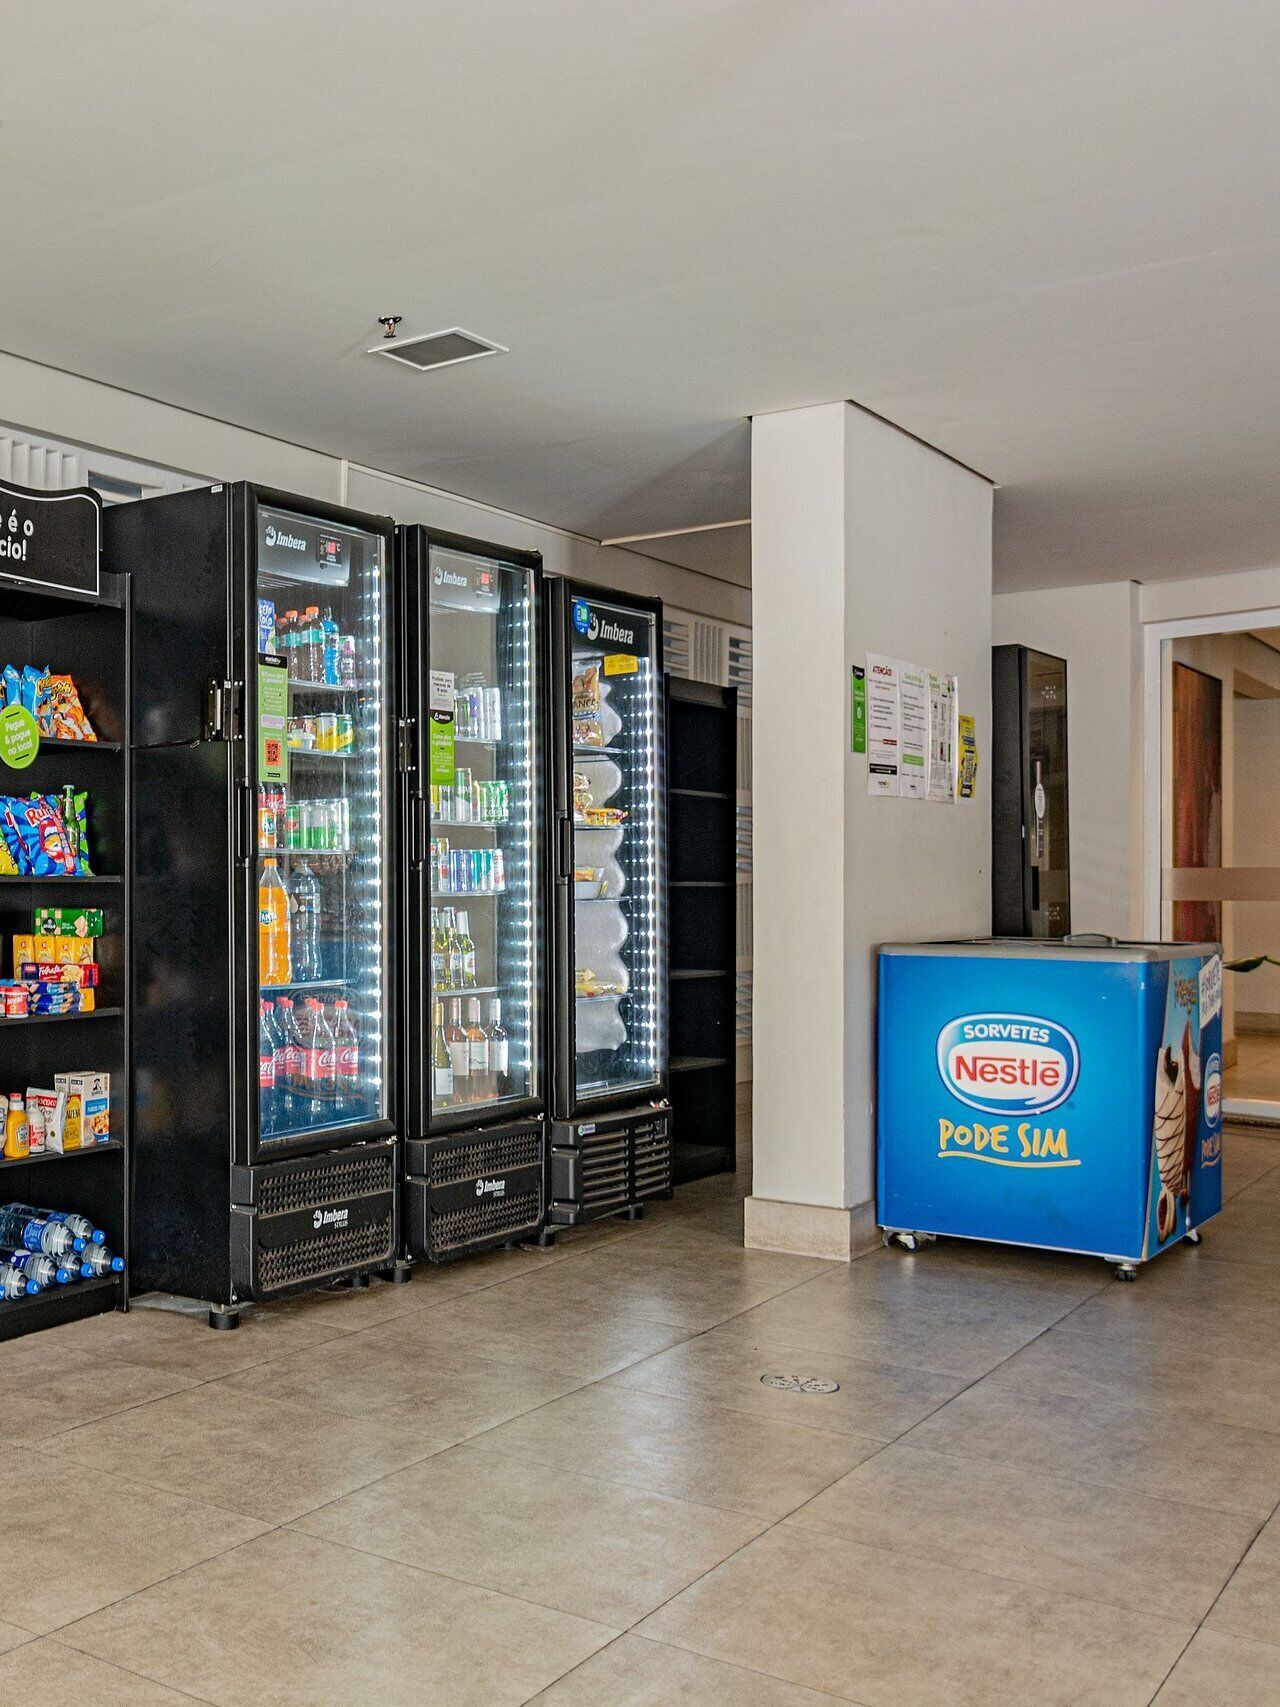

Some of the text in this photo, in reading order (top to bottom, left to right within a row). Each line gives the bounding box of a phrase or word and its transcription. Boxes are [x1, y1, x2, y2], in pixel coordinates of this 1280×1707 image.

[7, 509, 18, 533] é
[23, 518, 34, 537] o
[276, 533, 307, 551] Imbera
[443, 572, 468, 587] Imbera
[599, 616, 634, 645] Imbera
[5, 719, 26, 732] Pegue
[11, 729, 32, 743] pague
[8, 740, 33, 755] no local
[963, 1024, 1050, 1044] SORVETES
[954, 1055, 1060, 1087] Nestlé
[938, 1118, 1009, 1153] PODE
[484, 1179, 505, 1192] Imbera
[323, 1208, 348, 1225] Imbera
